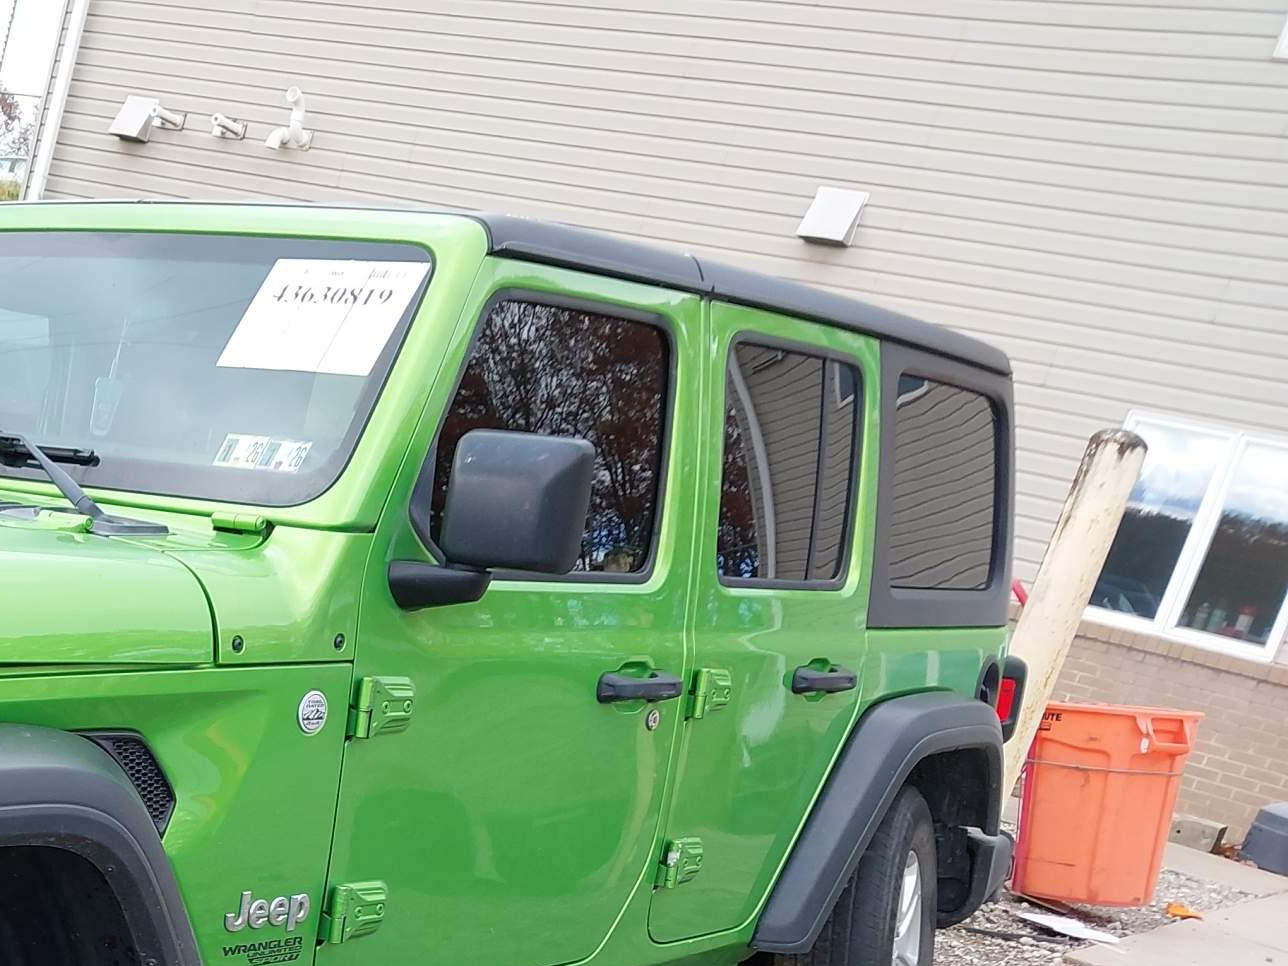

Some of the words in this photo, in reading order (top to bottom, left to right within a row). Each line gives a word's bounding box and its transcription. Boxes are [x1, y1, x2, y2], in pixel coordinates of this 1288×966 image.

[272, 284, 394, 306] 43630819
[1043, 712, 1063, 722] UTE
[224, 890, 310, 932] Jeep
[222, 936, 303, 957] WRANGLER
[247, 945, 303, 958] UNLIMITED
